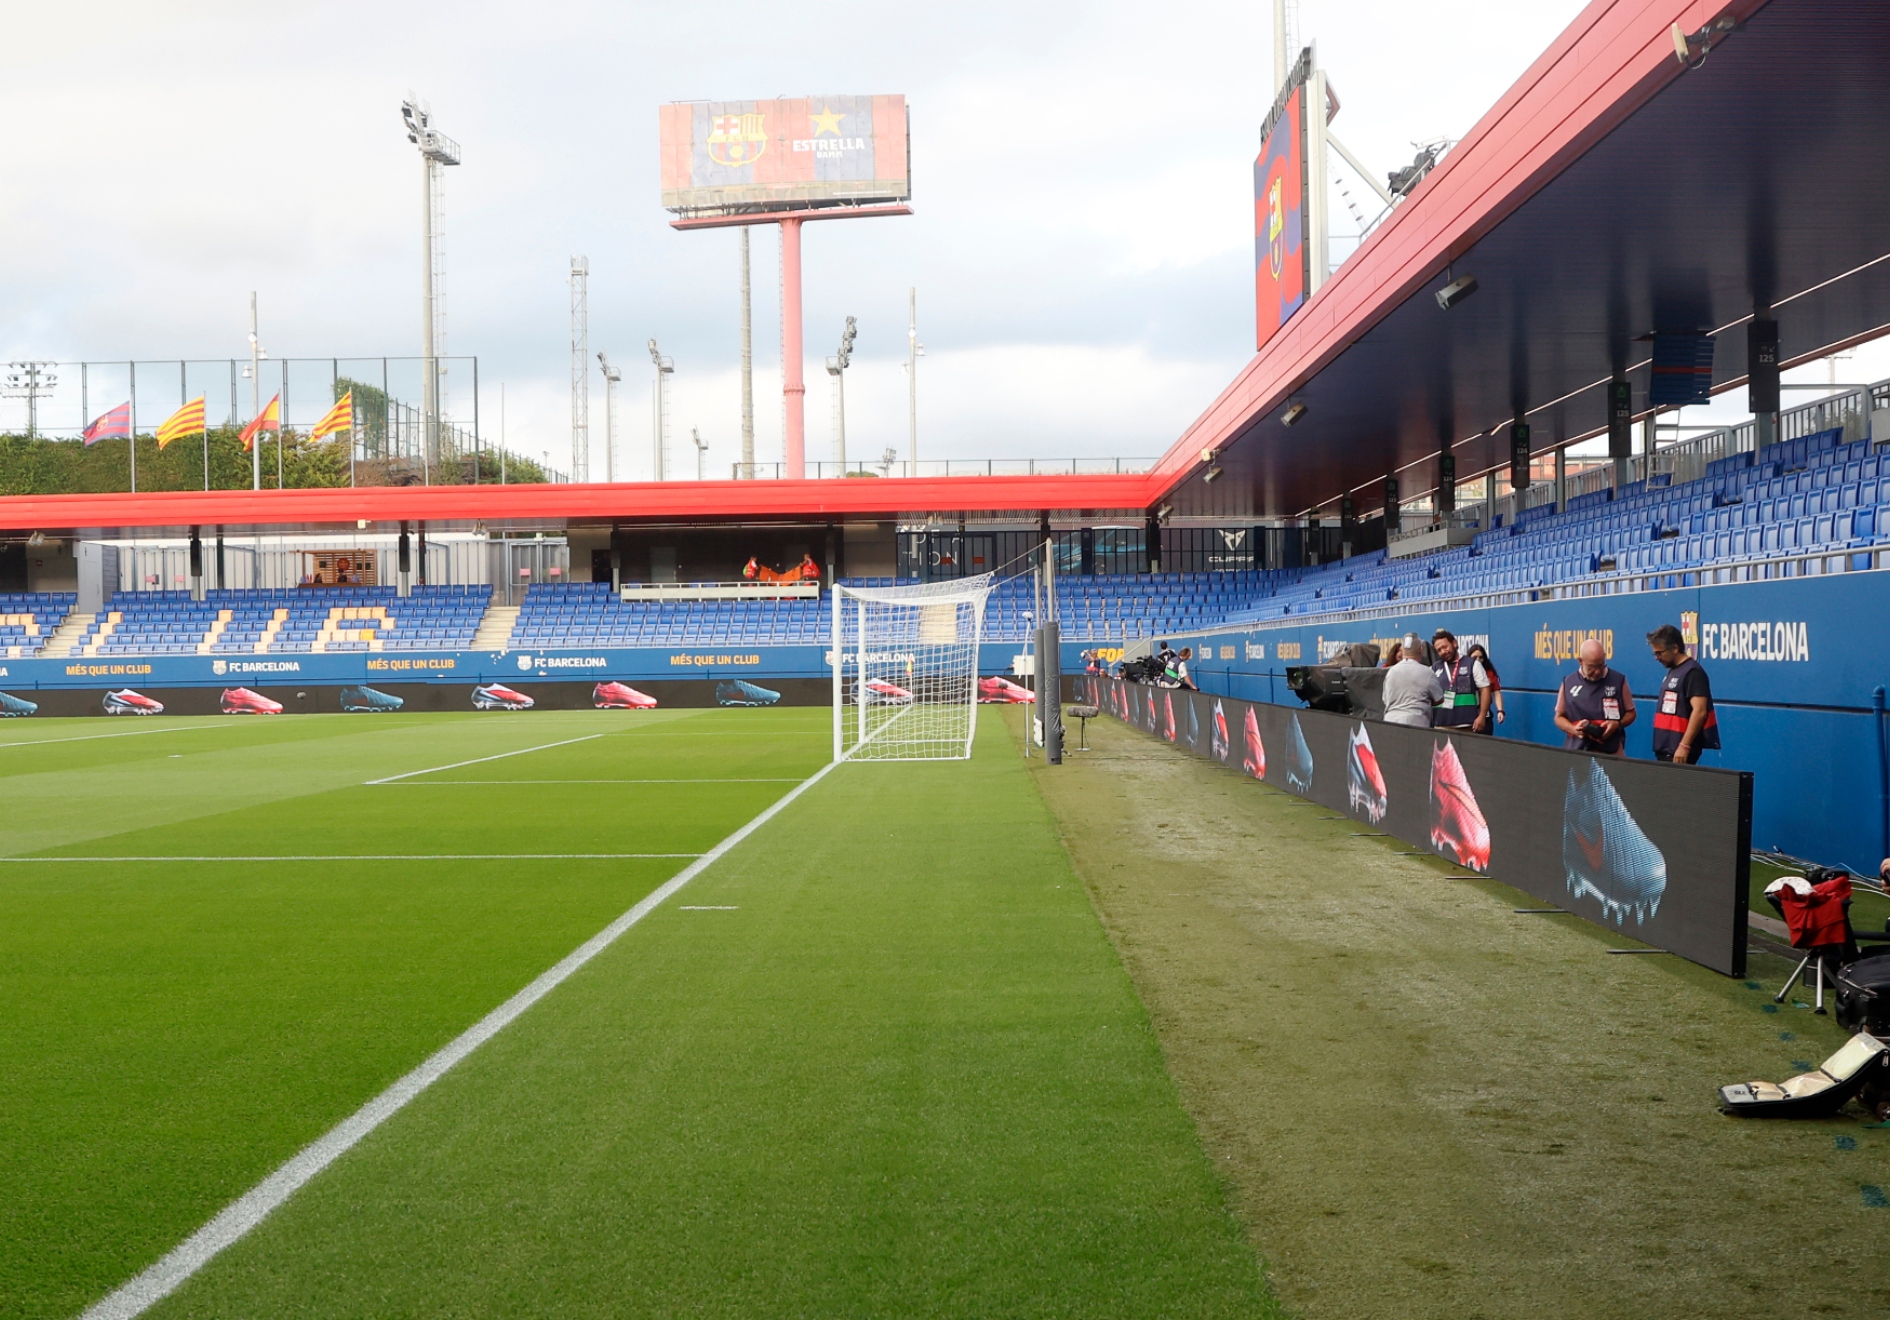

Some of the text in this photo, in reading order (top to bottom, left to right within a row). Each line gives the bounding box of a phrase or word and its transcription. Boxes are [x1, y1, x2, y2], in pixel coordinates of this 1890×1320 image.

[792, 138, 866, 152] ESTRELLA
[1759, 354, 1775, 363] 125
[1534, 622, 1553, 659] MÉS
[1553, 630, 1572, 666] QUE
[1702, 621, 1809, 662] FC BARCELONA
[367, 657, 455, 671] MÉS QUE UN CLUB
[534, 657, 607, 668] FC BARCELONA
[670, 653, 760, 667] MÉS QUE UN CLUB
[842, 653, 854, 663] FC
[66, 663, 152, 677] MÉS QUE UN CLUB
[229, 661, 300, 672] FC BARCELONA
